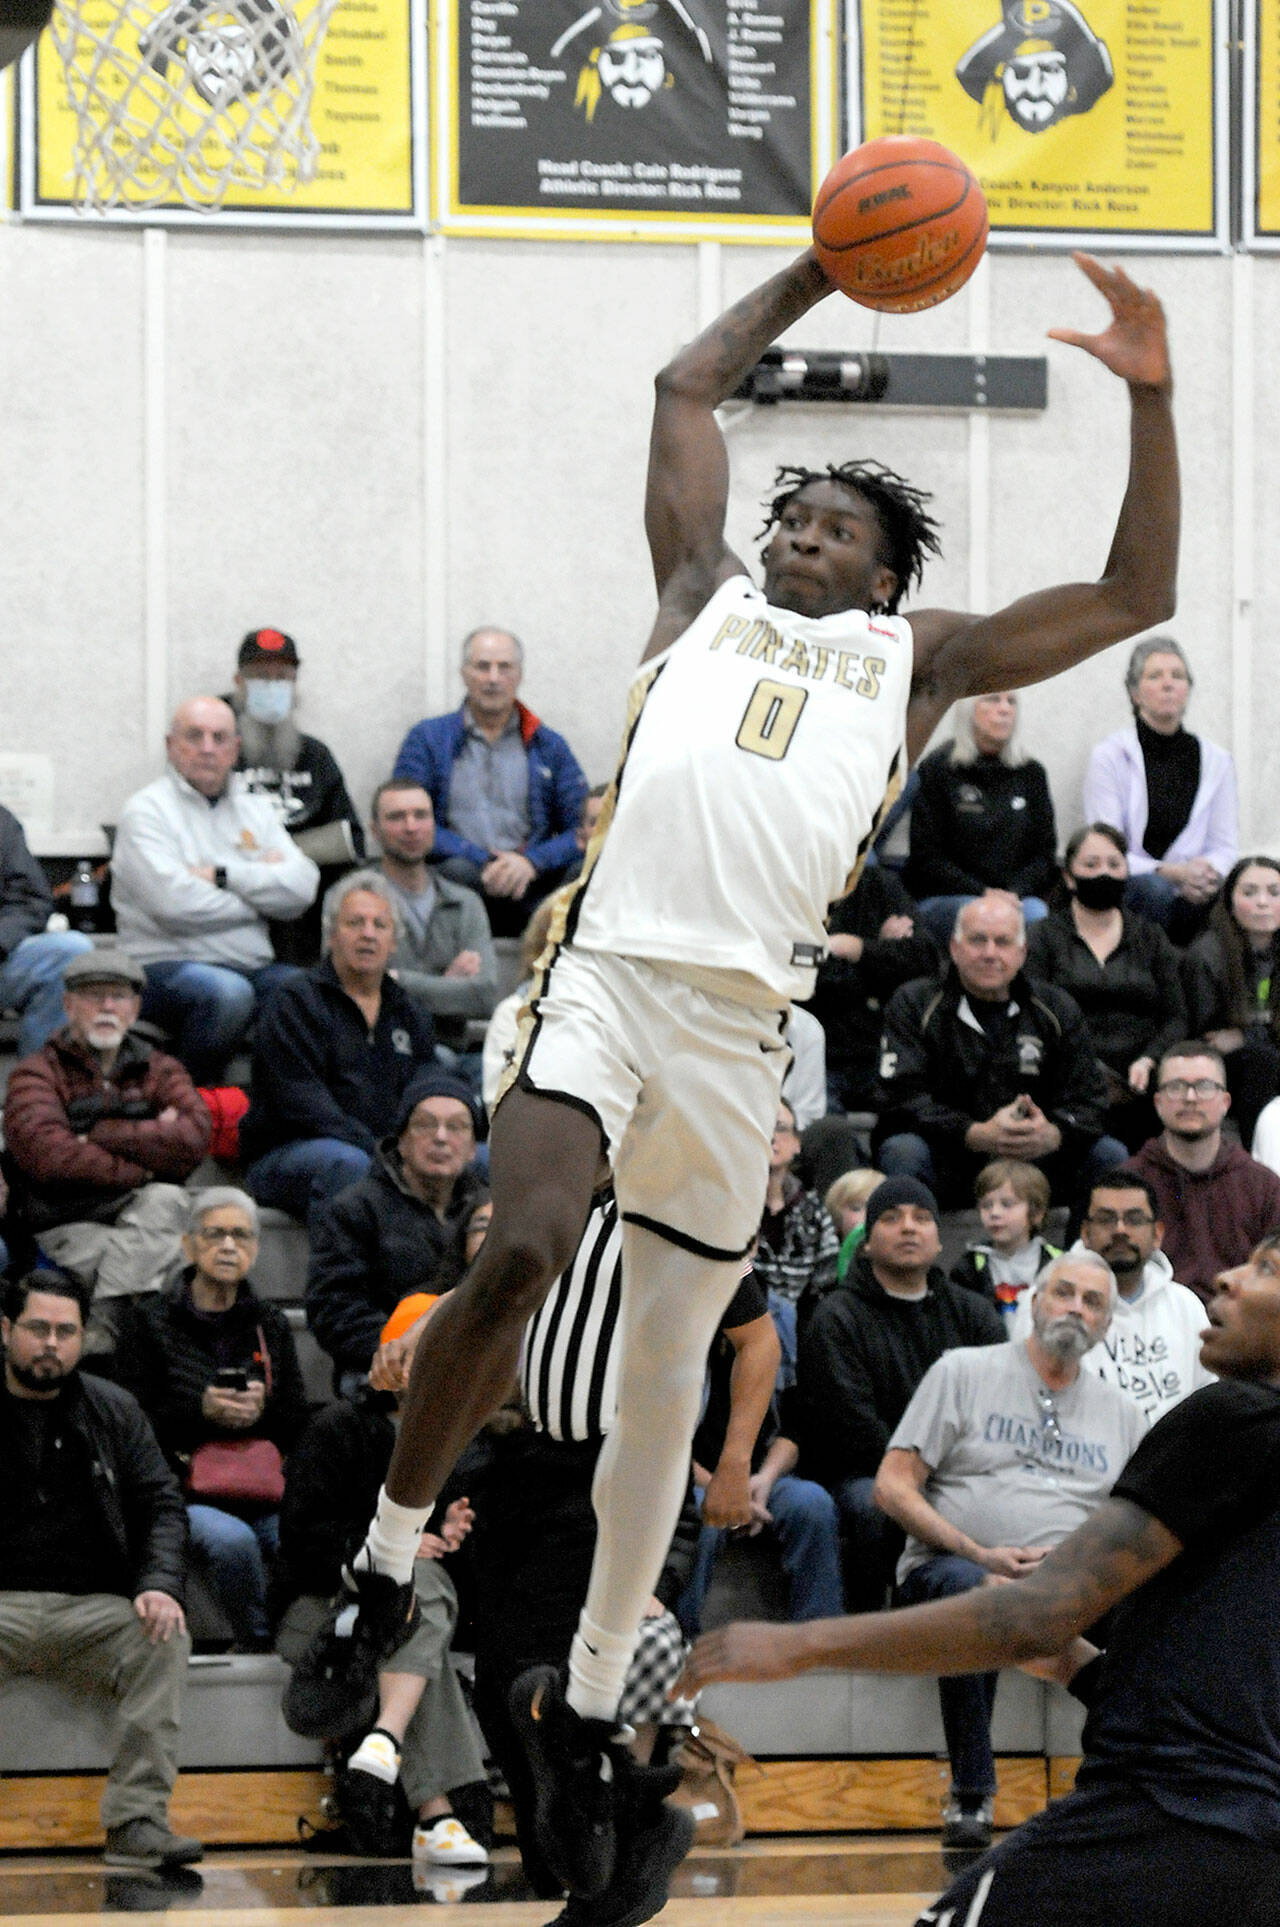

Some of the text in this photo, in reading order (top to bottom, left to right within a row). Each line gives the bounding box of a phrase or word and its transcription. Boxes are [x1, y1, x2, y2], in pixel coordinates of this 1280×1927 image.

[537, 159, 579, 176] Head
[708, 612, 887, 701] PIRATES
[735, 677, 809, 762] 0
